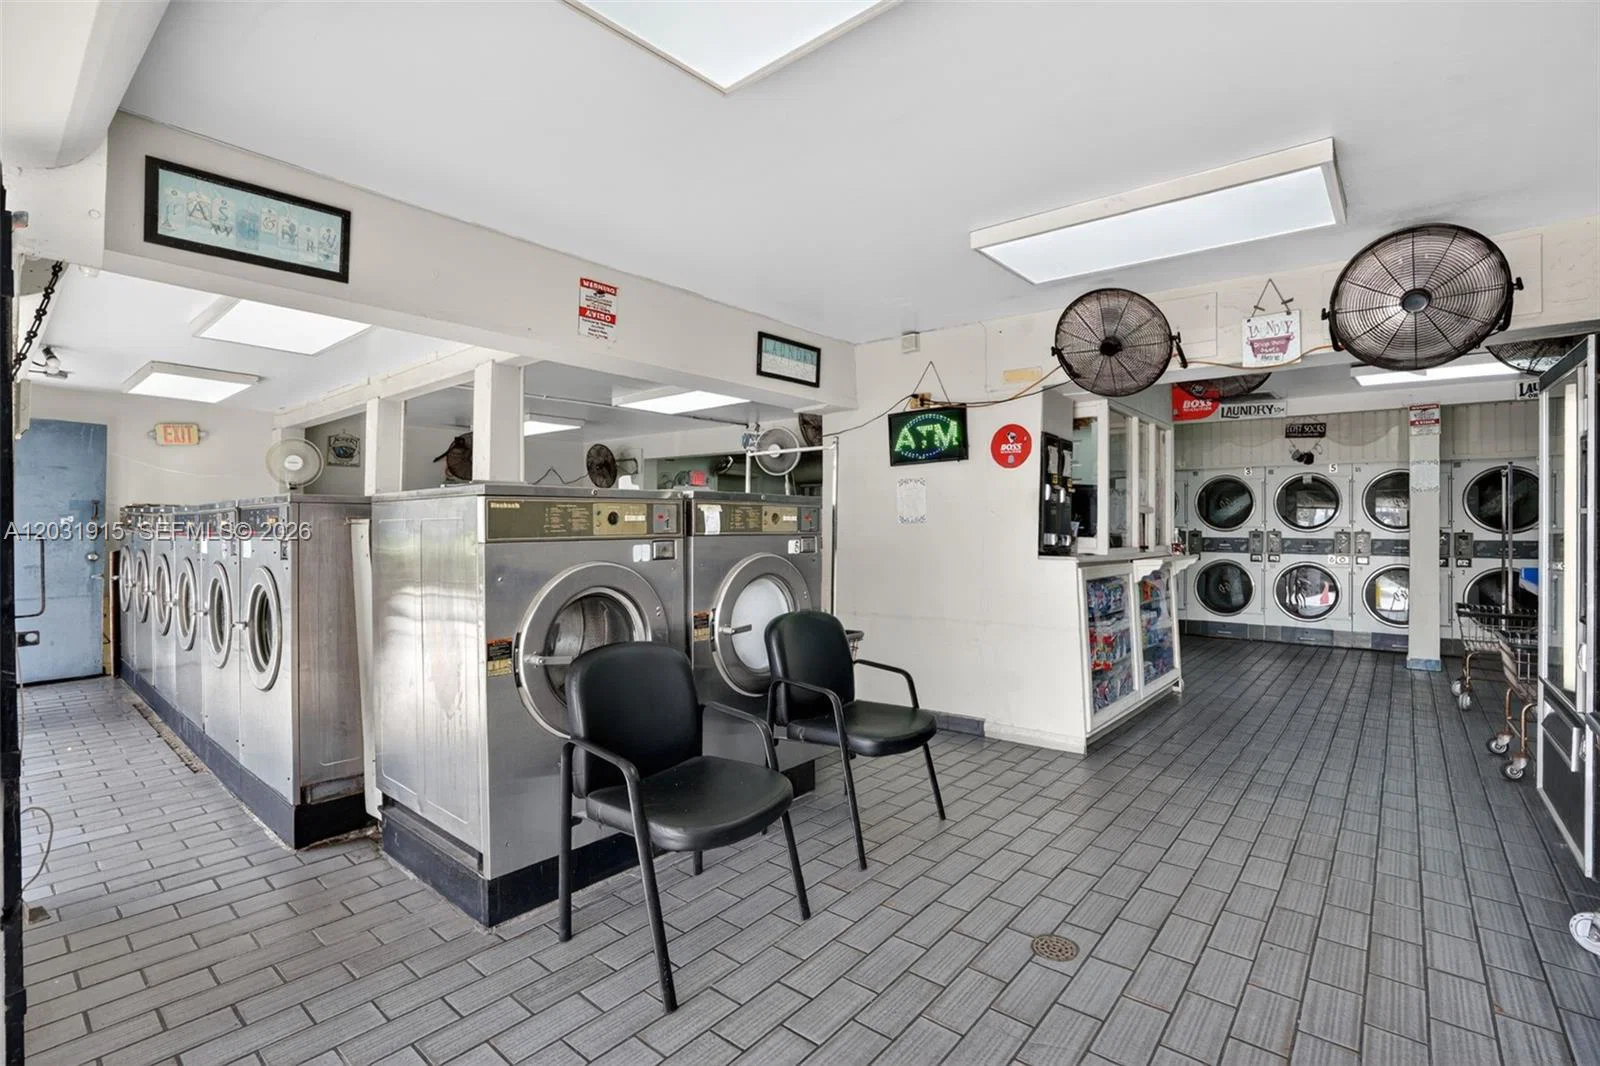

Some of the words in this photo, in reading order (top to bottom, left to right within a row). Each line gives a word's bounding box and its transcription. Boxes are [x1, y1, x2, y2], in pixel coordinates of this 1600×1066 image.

[585, 310, 612, 321] AVISO
[1182, 399, 1212, 409] BOSS
[1220, 404, 1274, 419] LAUNDRY
[163, 424, 193, 444] EXIT
[894, 419, 959, 452] ATM
